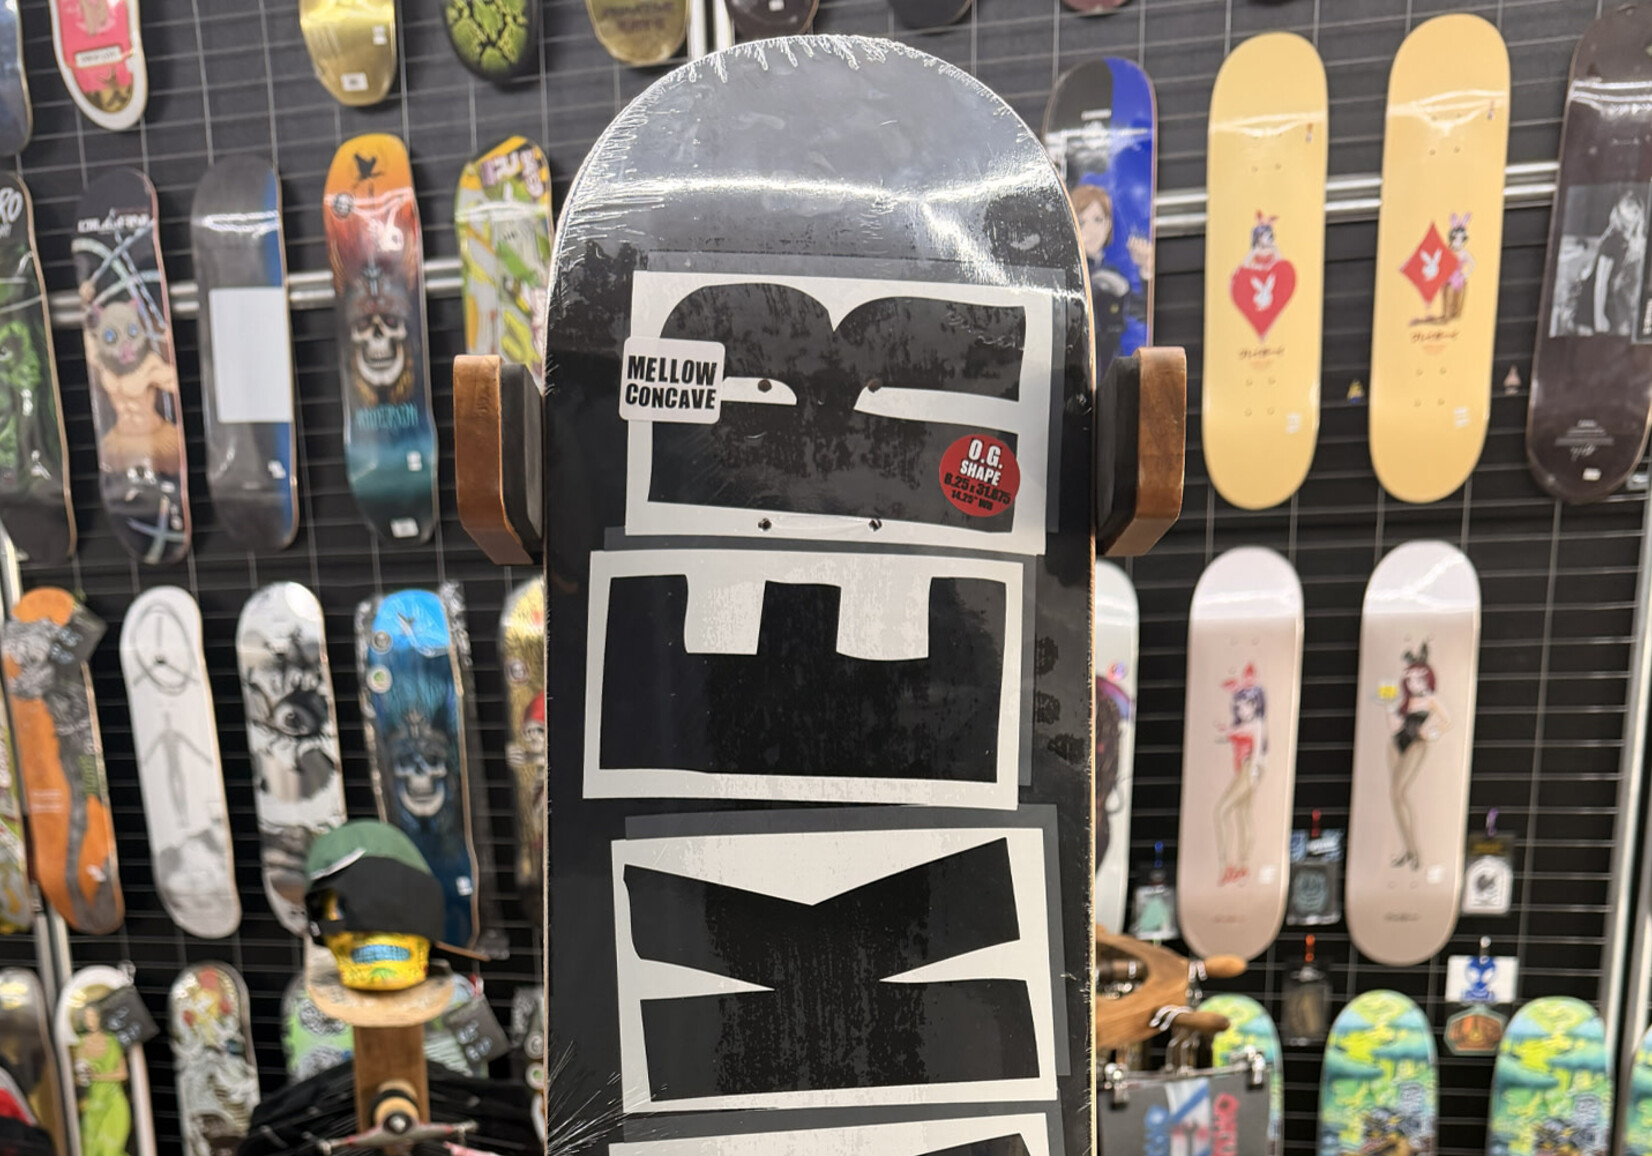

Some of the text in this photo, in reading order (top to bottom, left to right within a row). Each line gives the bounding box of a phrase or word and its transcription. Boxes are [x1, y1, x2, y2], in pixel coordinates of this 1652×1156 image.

[627, 355, 718, 386] MELLOW
[625, 383, 717, 410] CONCAVE
[968, 438, 1003, 469] O.G.
[959, 459, 1001, 486] SHAPE
[976, 483, 1011, 505] 31.875
